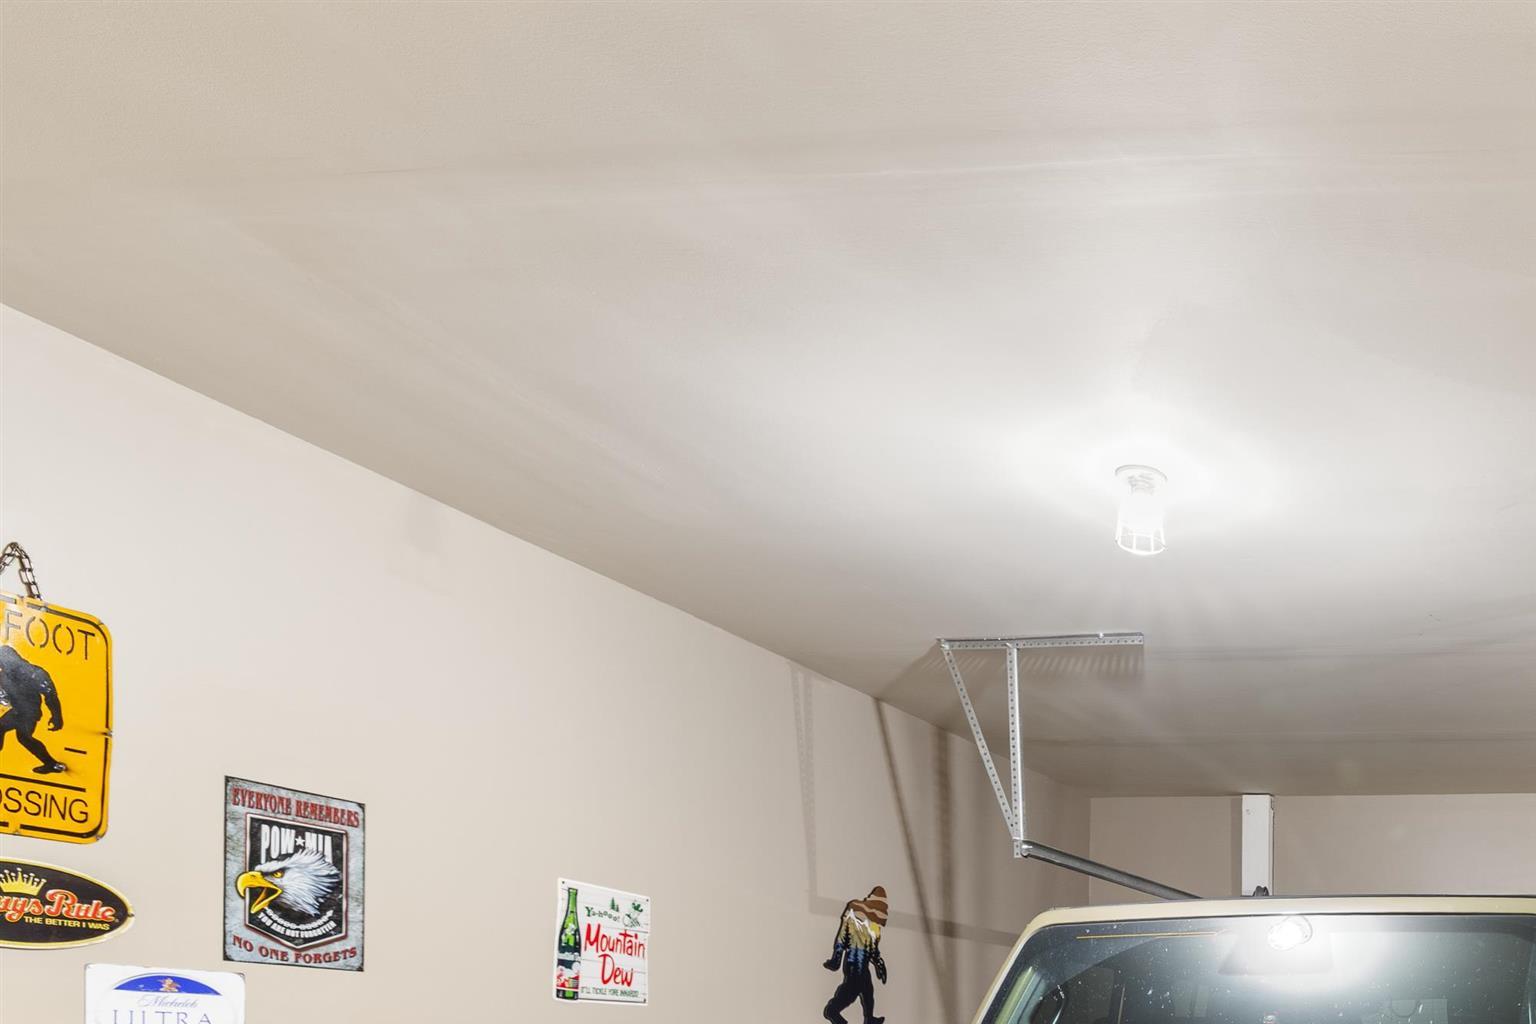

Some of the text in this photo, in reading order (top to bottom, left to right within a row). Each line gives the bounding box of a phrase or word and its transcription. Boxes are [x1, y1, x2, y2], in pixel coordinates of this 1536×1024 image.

[5, 608, 95, 660] FOOT
[0, 786, 89, 824] SSING
[231, 787, 360, 828] EVERYONE REMEMBERS
[261, 823, 333, 865] POW MIA
[45, 888, 116, 922] Rule
[23, 915, 43, 925] THE
[45, 917, 80, 928] BETTER
[88, 922, 110, 931] WAS
[257, 912, 337, 939] YOU ARE NOT FORGOTTEN
[584, 923, 646, 958] Mountain
[233, 934, 358, 964] NO ONE FORGETS
[598, 953, 633, 988] Dew
